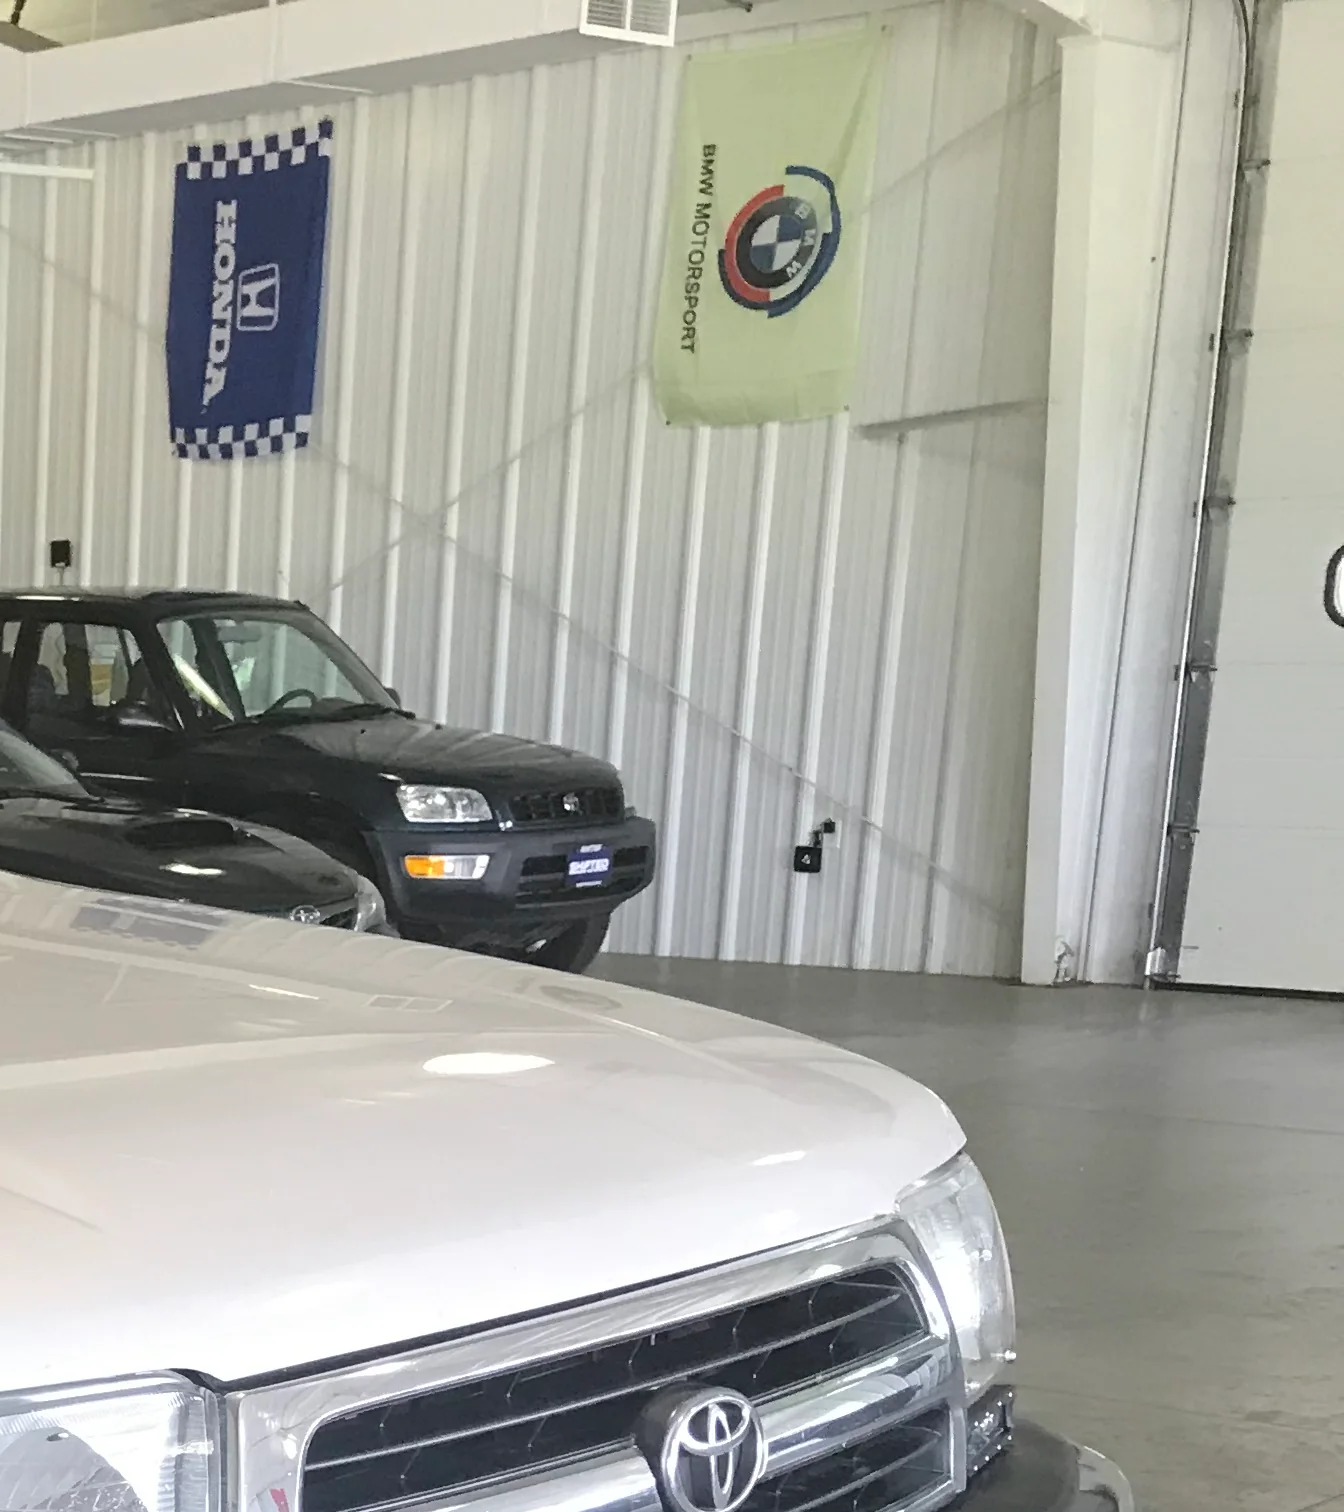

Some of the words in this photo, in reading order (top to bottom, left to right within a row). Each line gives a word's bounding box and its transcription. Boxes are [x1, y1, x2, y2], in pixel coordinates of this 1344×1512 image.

[701, 144, 717, 198] BMW
[201, 200, 238, 414] HONDA
[679, 202, 712, 354] MOTORSPORT
